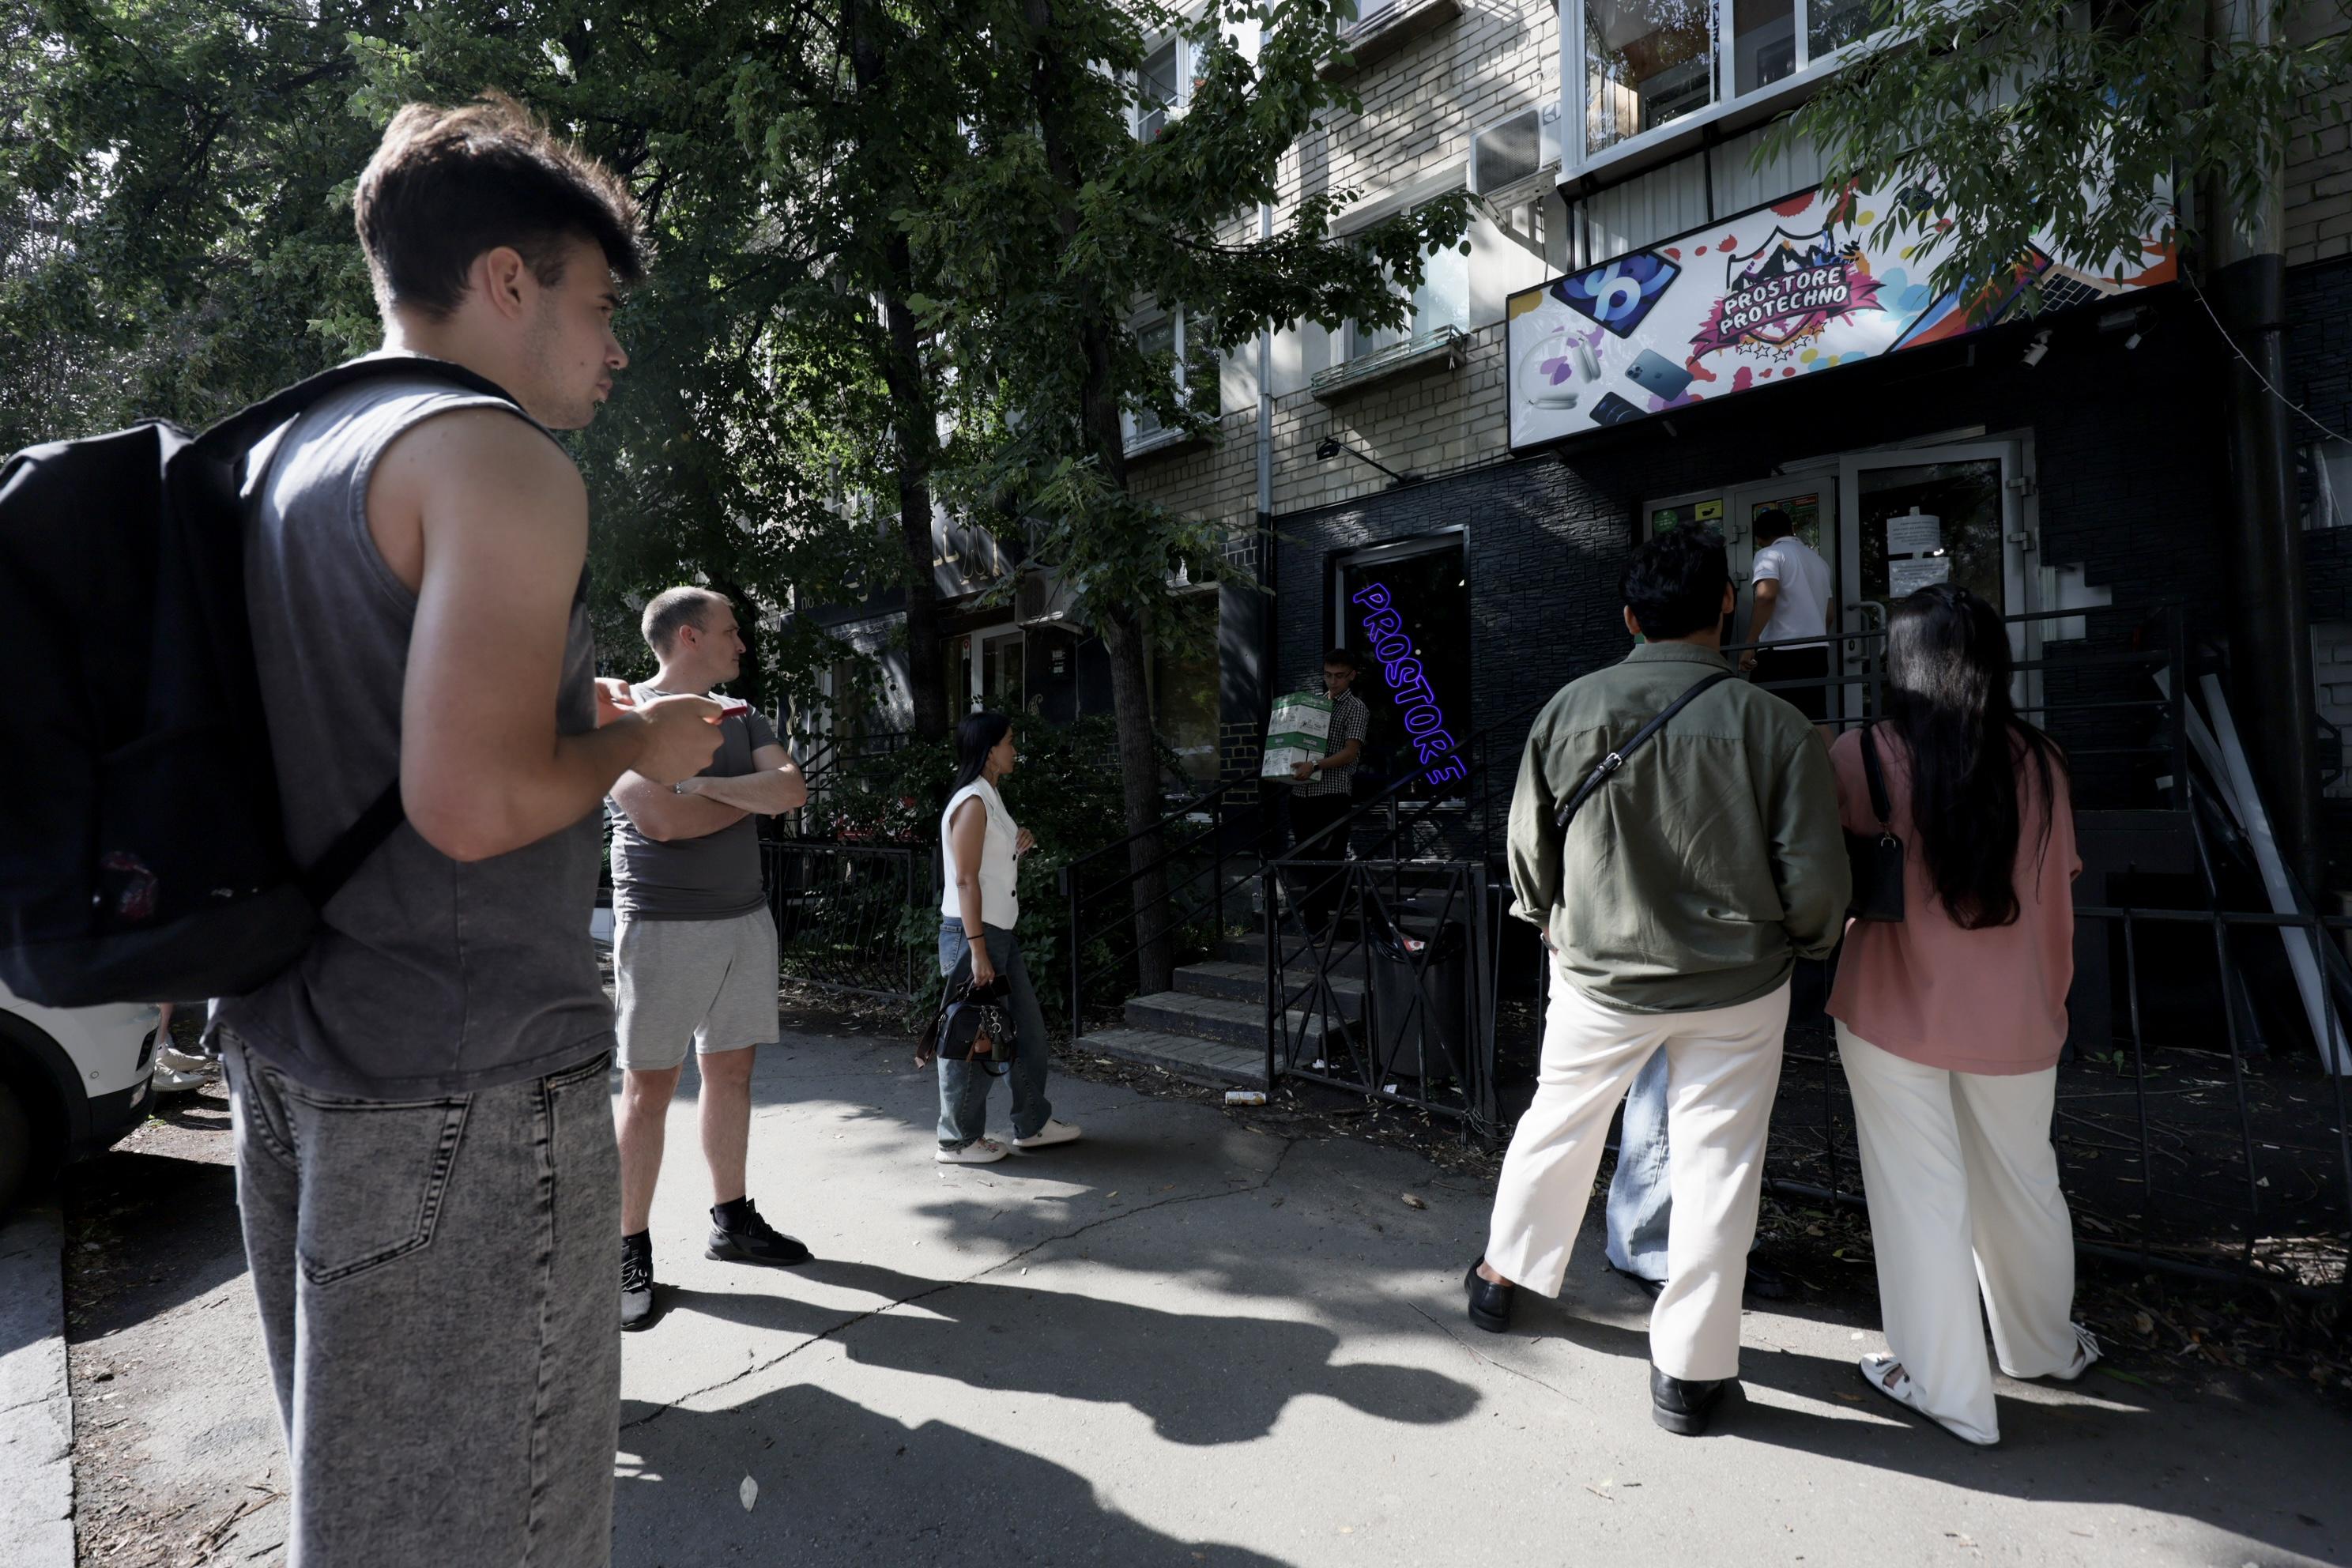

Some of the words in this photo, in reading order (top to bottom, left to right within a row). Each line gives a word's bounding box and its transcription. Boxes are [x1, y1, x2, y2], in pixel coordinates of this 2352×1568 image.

[1720, 285, 1847, 334] PROTECHNO
[1724, 266, 1842, 315] PROSTORE
[1353, 583, 1466, 784] PROSTORE
